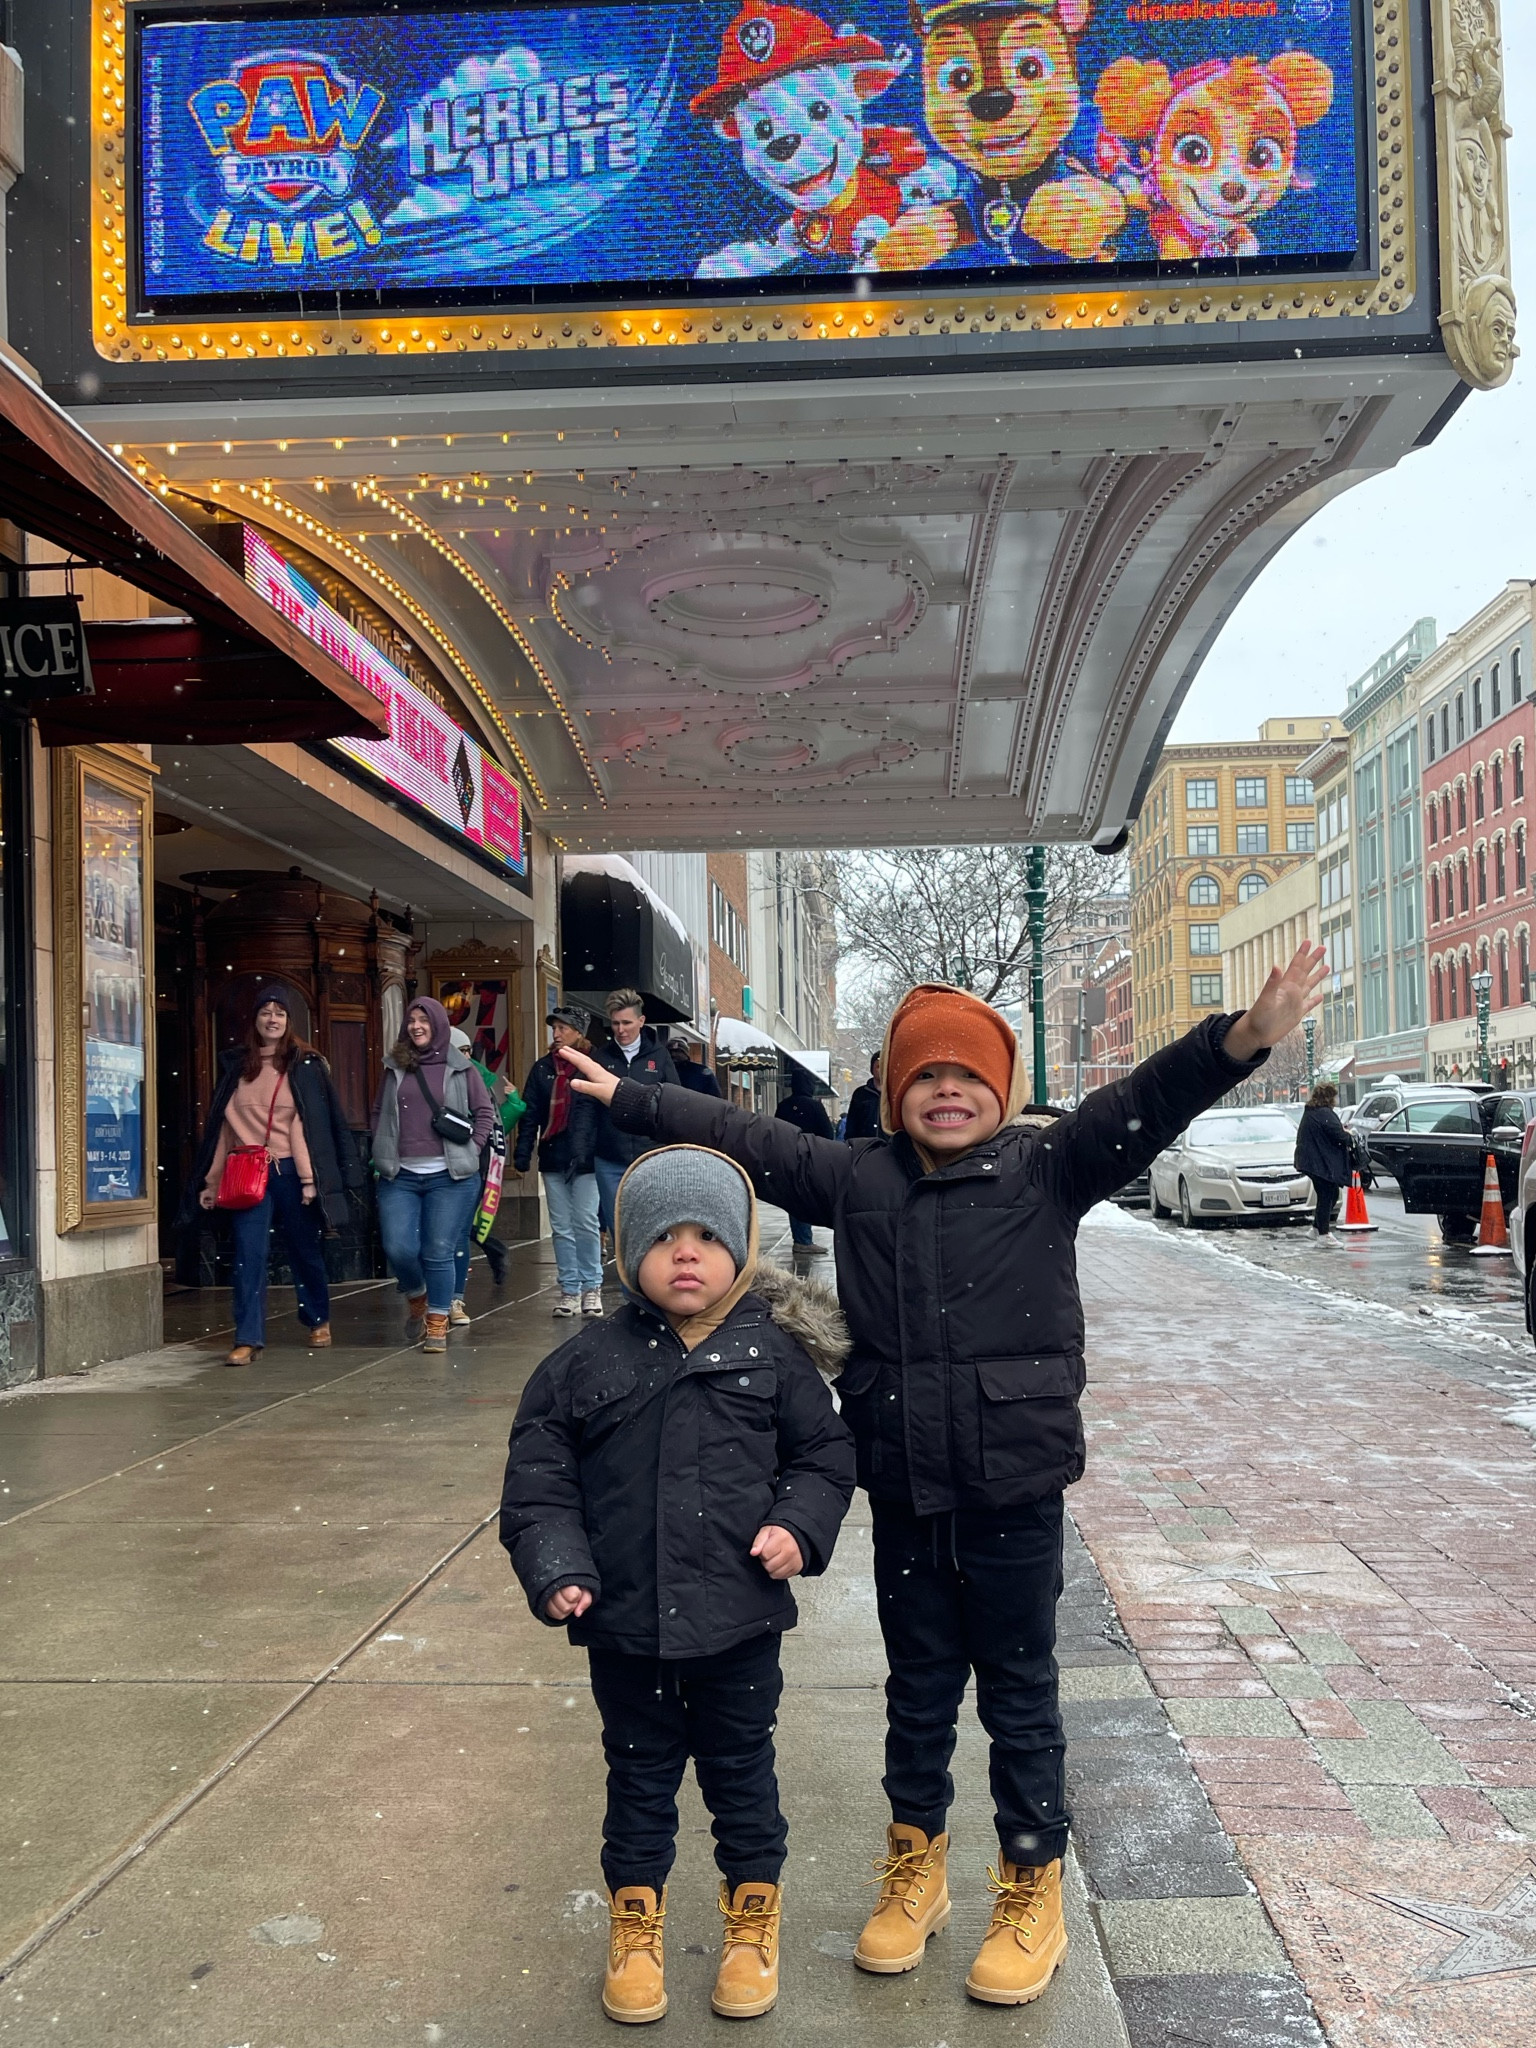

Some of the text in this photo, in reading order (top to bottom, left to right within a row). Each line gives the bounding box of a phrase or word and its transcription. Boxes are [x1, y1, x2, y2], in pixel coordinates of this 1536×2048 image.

[187, 75, 386, 156] PAW
[405, 69, 633, 178] HEROES
[233, 157, 339, 183] PATROL
[469, 121, 640, 200] UNITE
[202, 199, 384, 265] LIVE!
[87, 1150, 100, 1162] MAY
[1281, 1873, 1315, 1909] JERRY
[1303, 1914, 1344, 1963] STILLER
